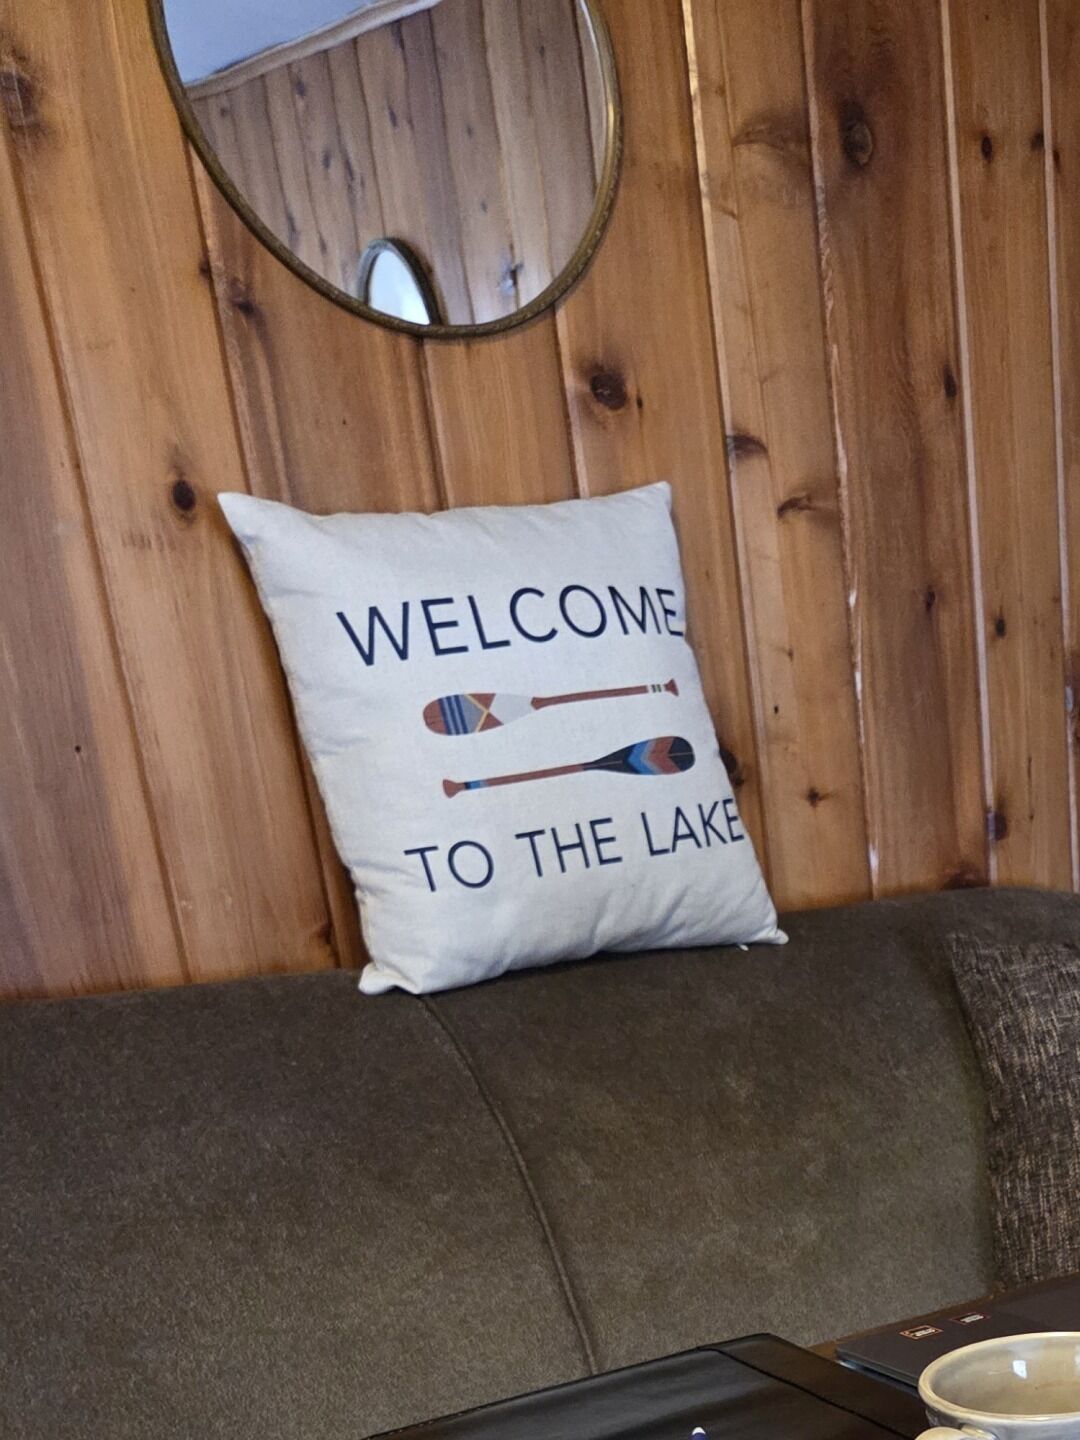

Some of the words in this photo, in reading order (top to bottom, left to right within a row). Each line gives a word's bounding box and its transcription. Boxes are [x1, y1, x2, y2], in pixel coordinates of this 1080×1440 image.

[335, 584, 685, 667] WELCOME
[403, 840, 495, 893] TO
[514, 817, 623, 878] THE
[640, 798, 746, 857] LAKE
